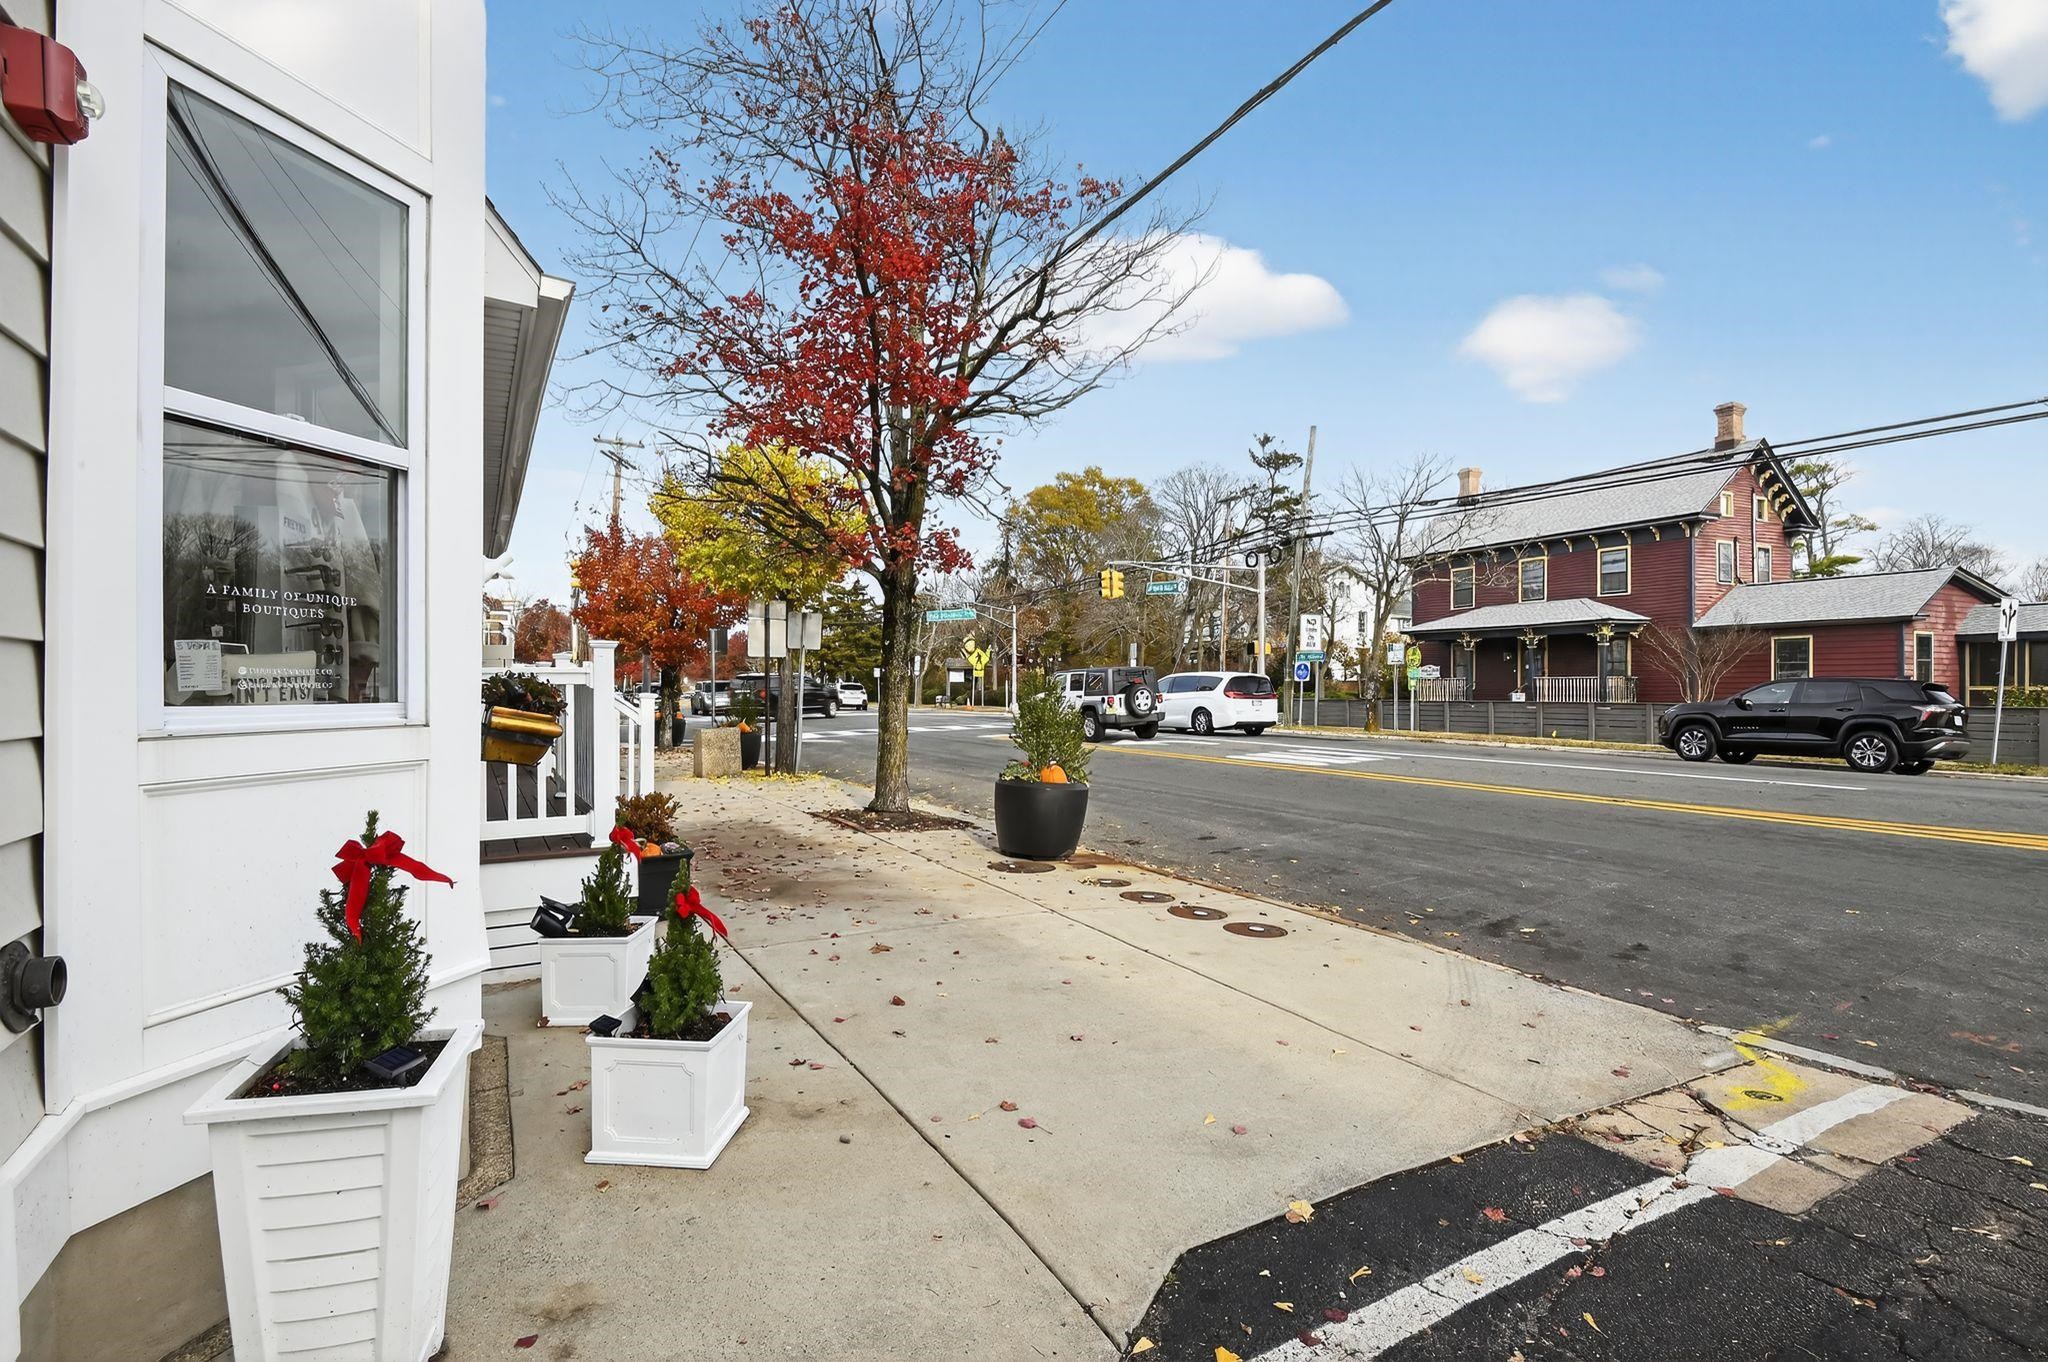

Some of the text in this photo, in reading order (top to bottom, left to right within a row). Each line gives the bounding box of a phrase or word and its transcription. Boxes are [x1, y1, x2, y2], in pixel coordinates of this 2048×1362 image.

[206, 583, 357, 608] A FAMILY OF UNIQUE
[242, 602, 325, 619] BOUTIQUES
